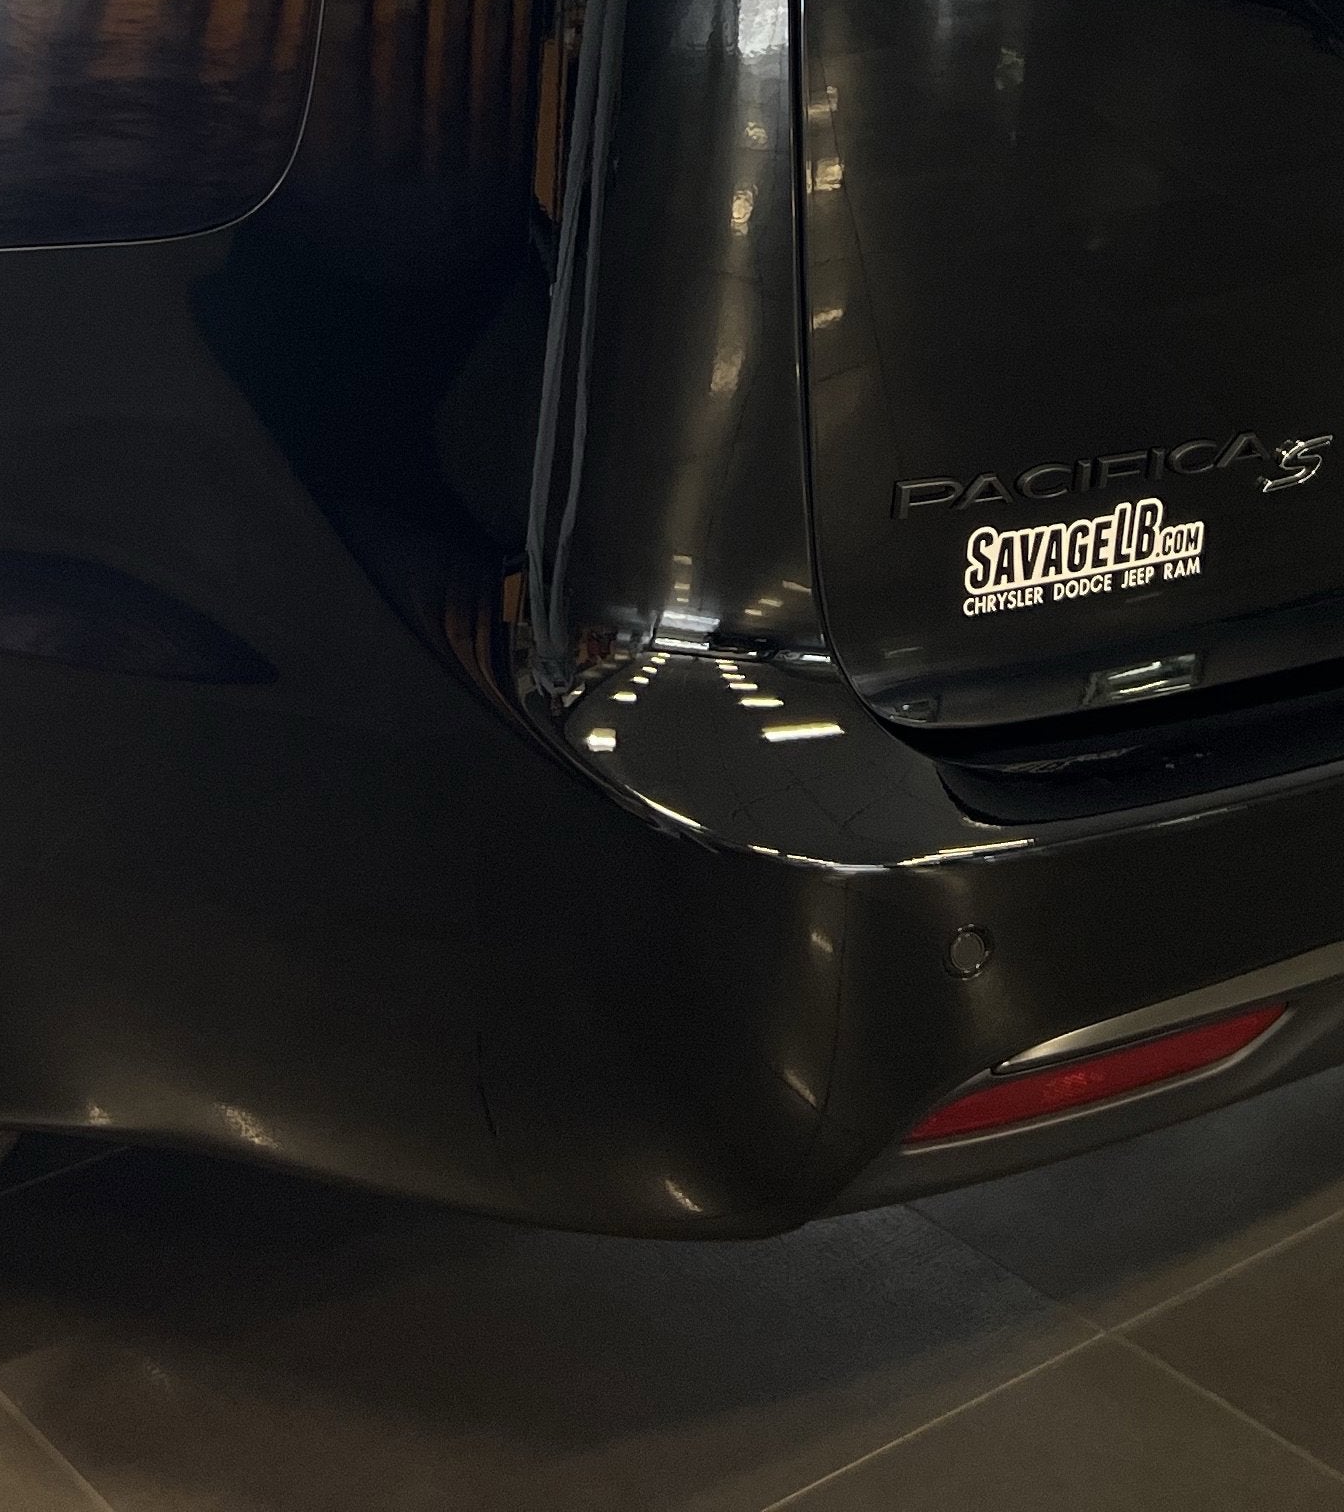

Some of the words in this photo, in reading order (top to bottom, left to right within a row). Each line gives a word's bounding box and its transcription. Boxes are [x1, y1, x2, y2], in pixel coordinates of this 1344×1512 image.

[890, 431, 1270, 519] PACIFICA
[1258, 435, 1334, 492] S
[962, 586, 1044, 617] CHRYSLER
[1121, 566, 1155, 589] JEEP
[1163, 557, 1201, 580] RAM
